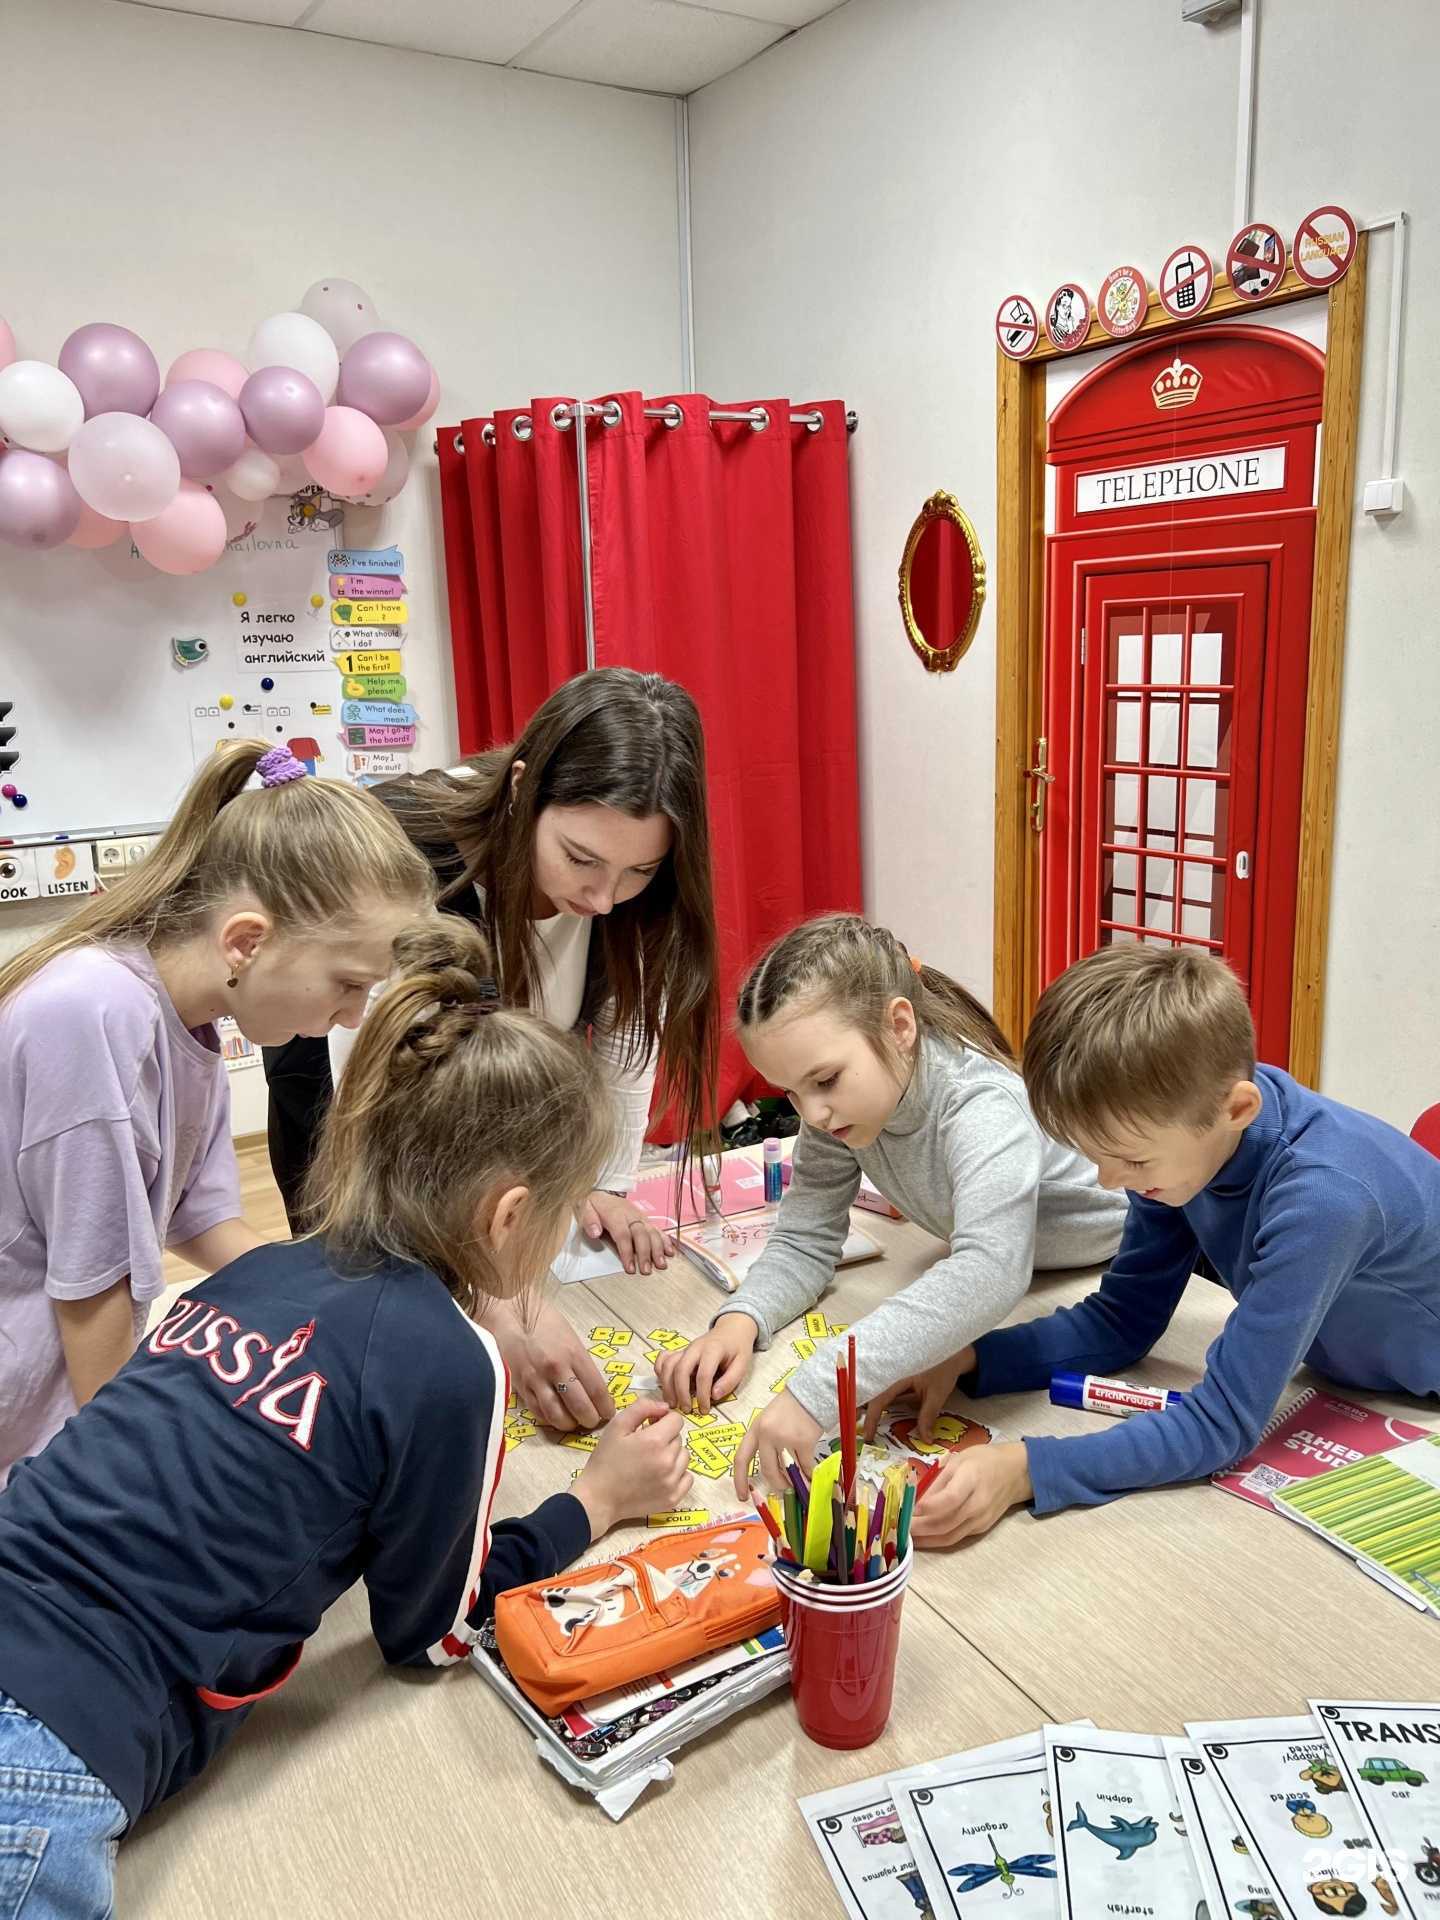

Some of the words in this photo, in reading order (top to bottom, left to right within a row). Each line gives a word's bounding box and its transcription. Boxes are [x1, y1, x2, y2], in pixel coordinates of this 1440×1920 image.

[1096, 458, 1260, 504] TELEPHONE
[369, 559, 401, 568] finished!
[350, 577, 364, 585] I'm
[381, 604, 401, 612] have
[240, 612, 250, 624] Я
[256, 613, 295, 624] легко
[353, 630, 373, 638] What
[374, 630, 401, 638] should
[242, 632, 294, 647] изучаю
[358, 640, 372, 648] do?
[244, 650, 325, 665] английский
[357, 654, 374, 662] Can
[346, 655, 353, 672] 1
[358, 664, 372, 672] the
[373, 663, 391, 671] first?
[367, 678, 385, 686] Help
[367, 687, 396, 696] please!
[365, 705, 386, 713] What
[388, 706, 406, 714] does
[368, 727, 385, 735] May
[384, 735, 410, 743] board?
[373, 754, 389, 762] May
[48, 881, 89, 895] LISTEN
[0, 887, 28, 900] OOK
[666, 1515, 691, 1523] COLD
[1096, 1793, 1133, 1804] dolphin
[1270, 1791, 1311, 1802] scared
[1391, 1791, 1411, 1799] car
[852, 1812, 874, 1823] sleep
[875, 1809, 886, 1817] to
[961, 1822, 1009, 1836] dragonfly
[862, 1865, 898, 1882] pajamas
[1107, 1903, 1154, 1916] starfish
